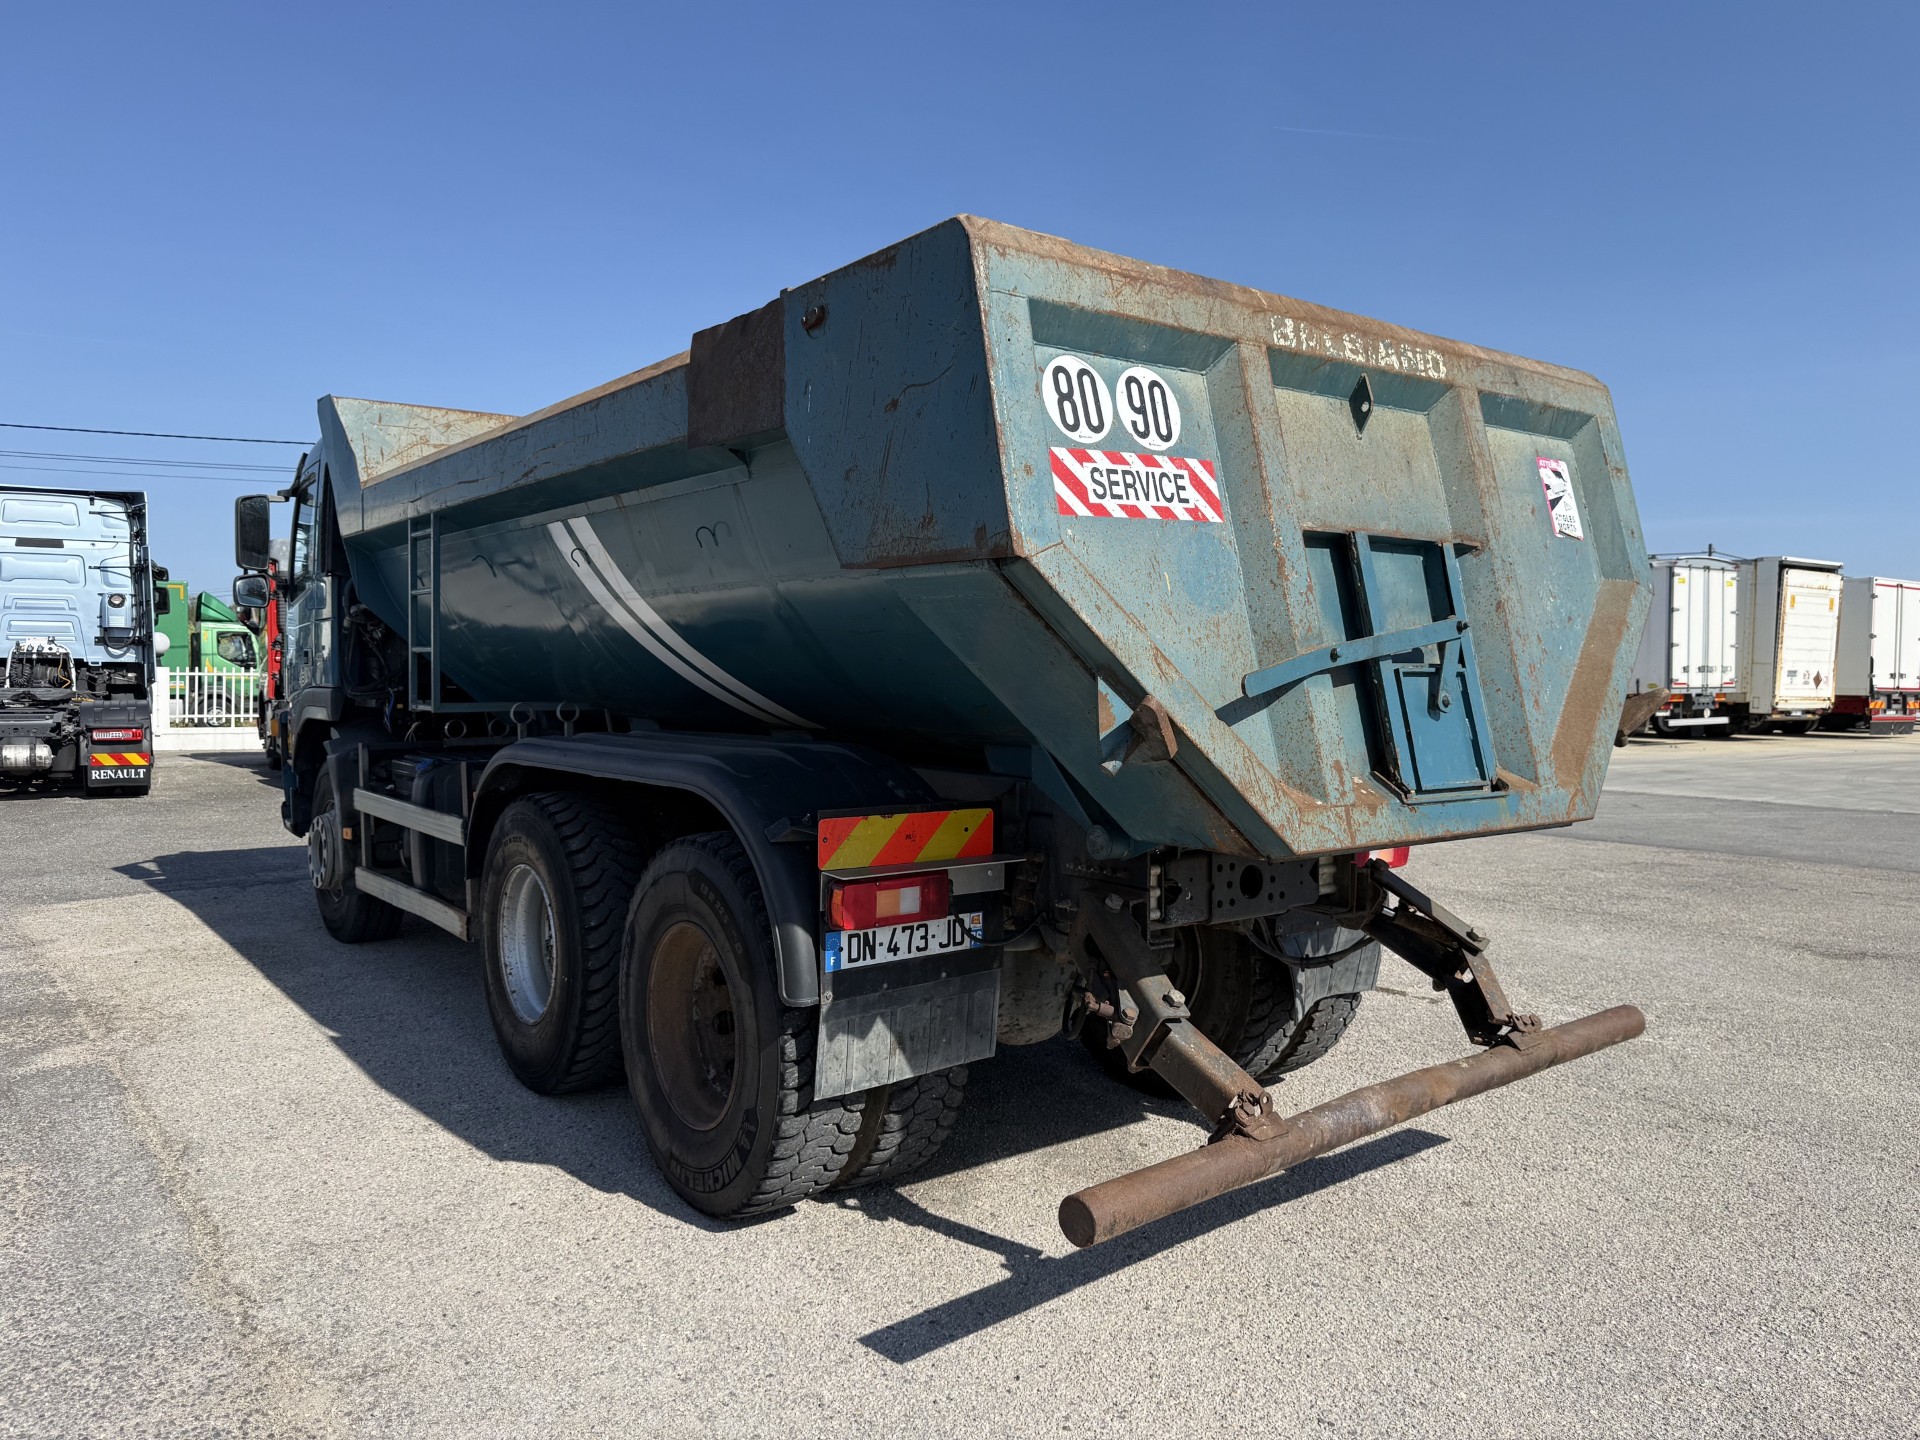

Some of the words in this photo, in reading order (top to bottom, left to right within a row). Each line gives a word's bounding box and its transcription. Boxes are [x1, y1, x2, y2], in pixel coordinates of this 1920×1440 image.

[1053, 366, 1104, 433] 80
[1125, 376, 1172, 442] 90
[1090, 467, 1190, 504] SERVICE
[91, 768, 146, 780] RENAULT
[830, 956, 836, 966] F
[847, 918, 965, 963] DN-473-JD
[669, 1148, 742, 1192] MICHELIN
